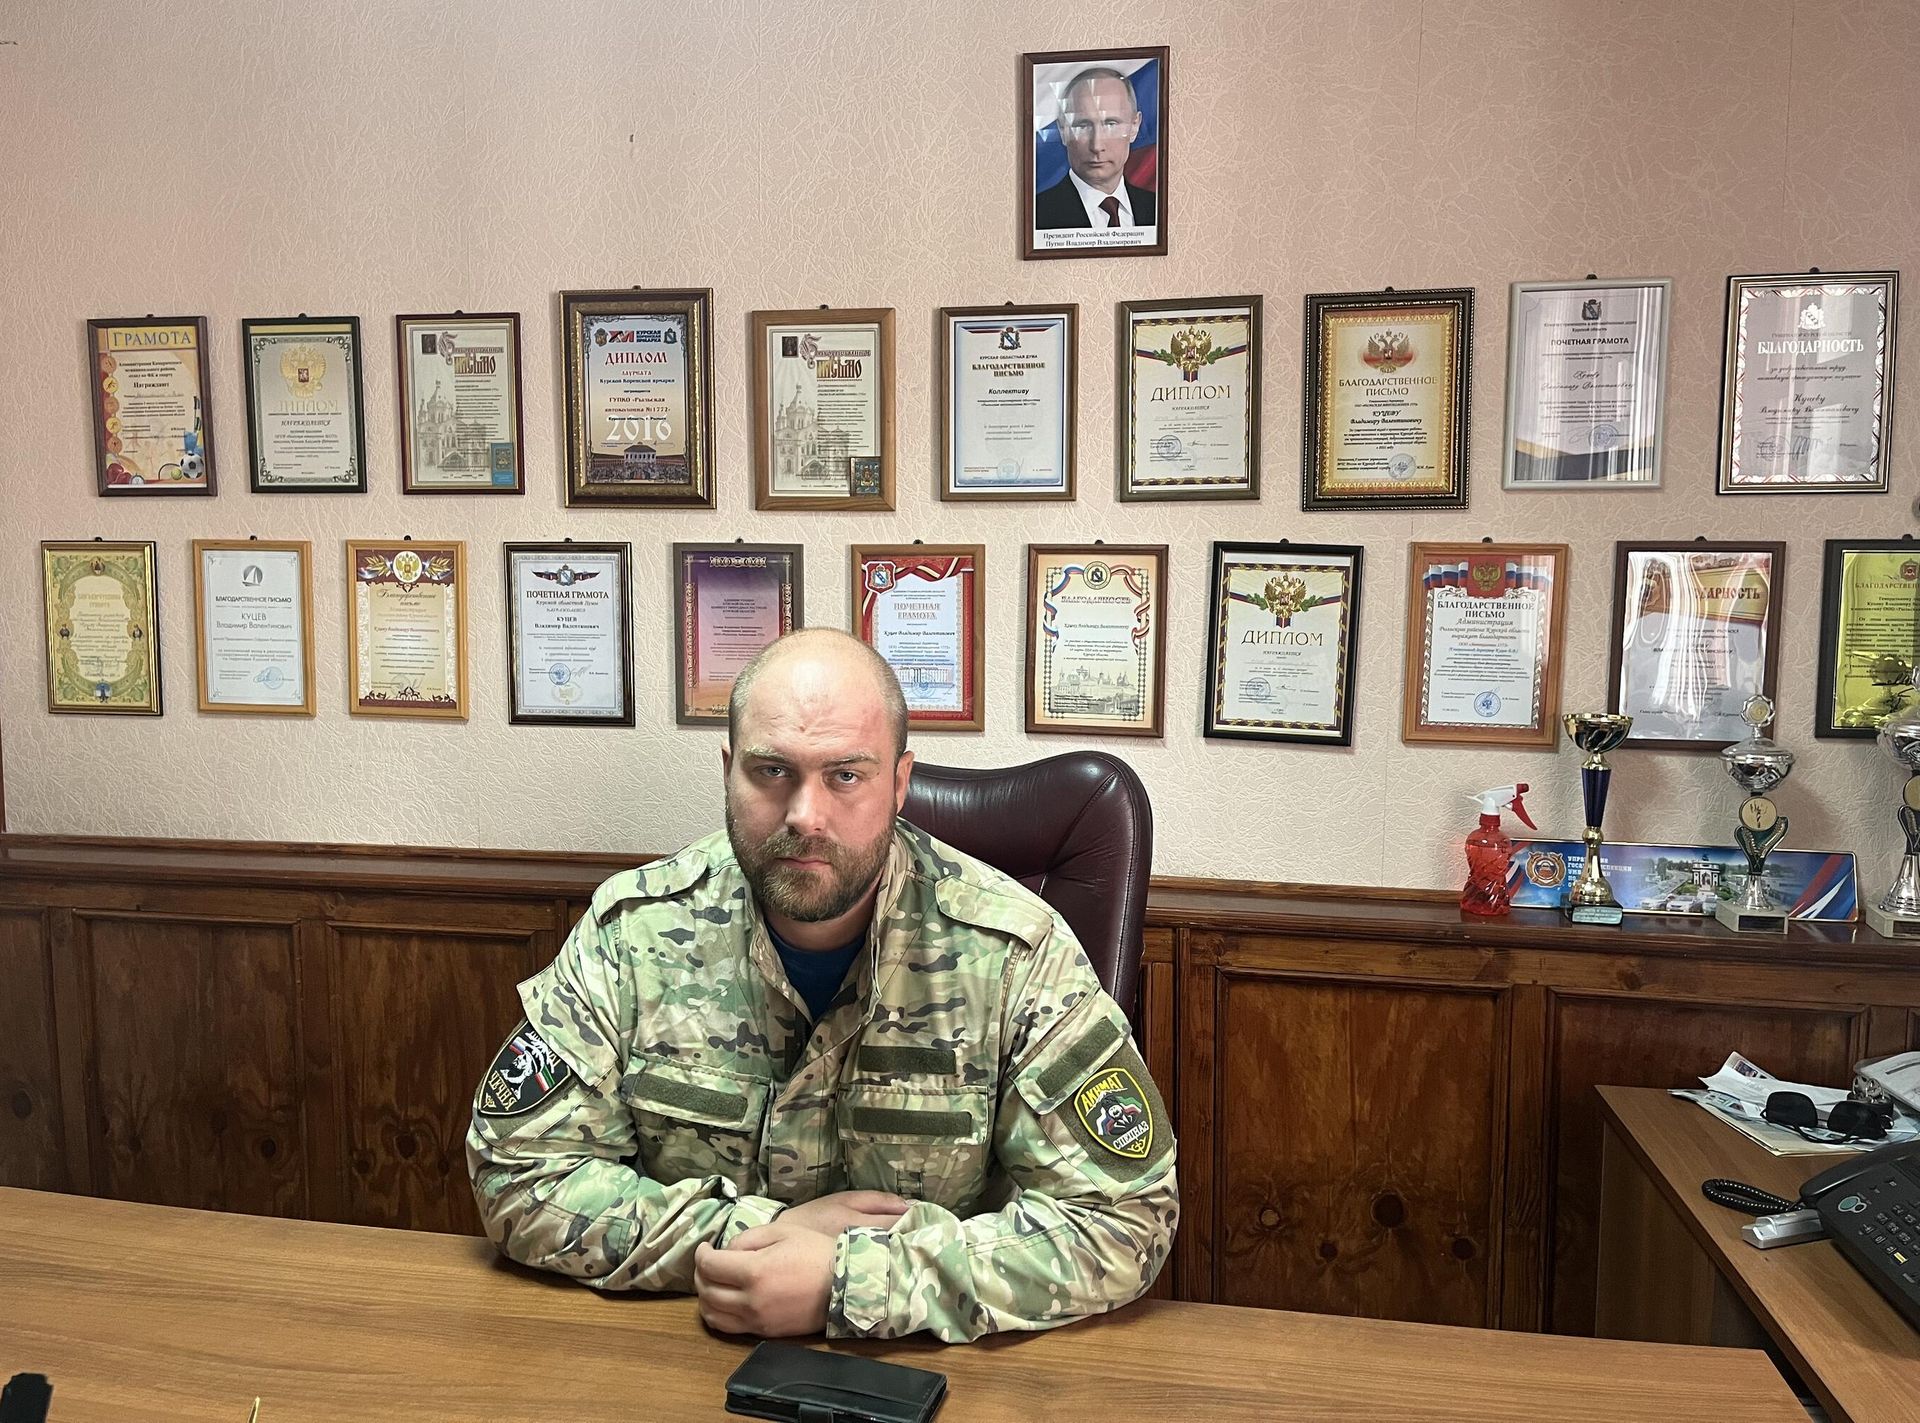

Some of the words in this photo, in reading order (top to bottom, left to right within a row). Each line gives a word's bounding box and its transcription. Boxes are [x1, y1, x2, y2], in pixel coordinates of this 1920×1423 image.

[1111, 230, 1145, 238] Федерации
[113, 331, 191, 346] ГРАМОТА
[1757, 339, 1864, 355] БЛАГОДАРНОСТЬ
[605, 352, 667, 365] ДИПЛОМ
[972, 362, 1046, 370] БЛАГОДАРСТВЕННОЕ
[1339, 377, 1437, 387] БЛАГОДАРСТВЕННОЕ
[1151, 385, 1230, 402] ДИПЛОМ
[1366, 387, 1409, 396] ПИСЬМО
[606, 414, 672, 440] 2016
[526, 590, 570, 598] ПОЧЕТНАЯ
[572, 591, 609, 599] ГРАМОТА
[1437, 601, 1534, 610] БЛАГОДАРСТВЕННОЕ
[241, 613, 267, 621] КУЦЕВ
[898, 612, 937, 620] ГРАМОТА
[1465, 610, 1505, 618] ПИСЬМО
[216, 621, 248, 630] Владимир
[1456, 618, 1514, 627] Администрация
[1241, 630, 1322, 646] ДИПЛОМ
[488, 1070, 517, 1111] ЧЕЧНЯ
[1080, 1072, 1124, 1113] AKHMAT
